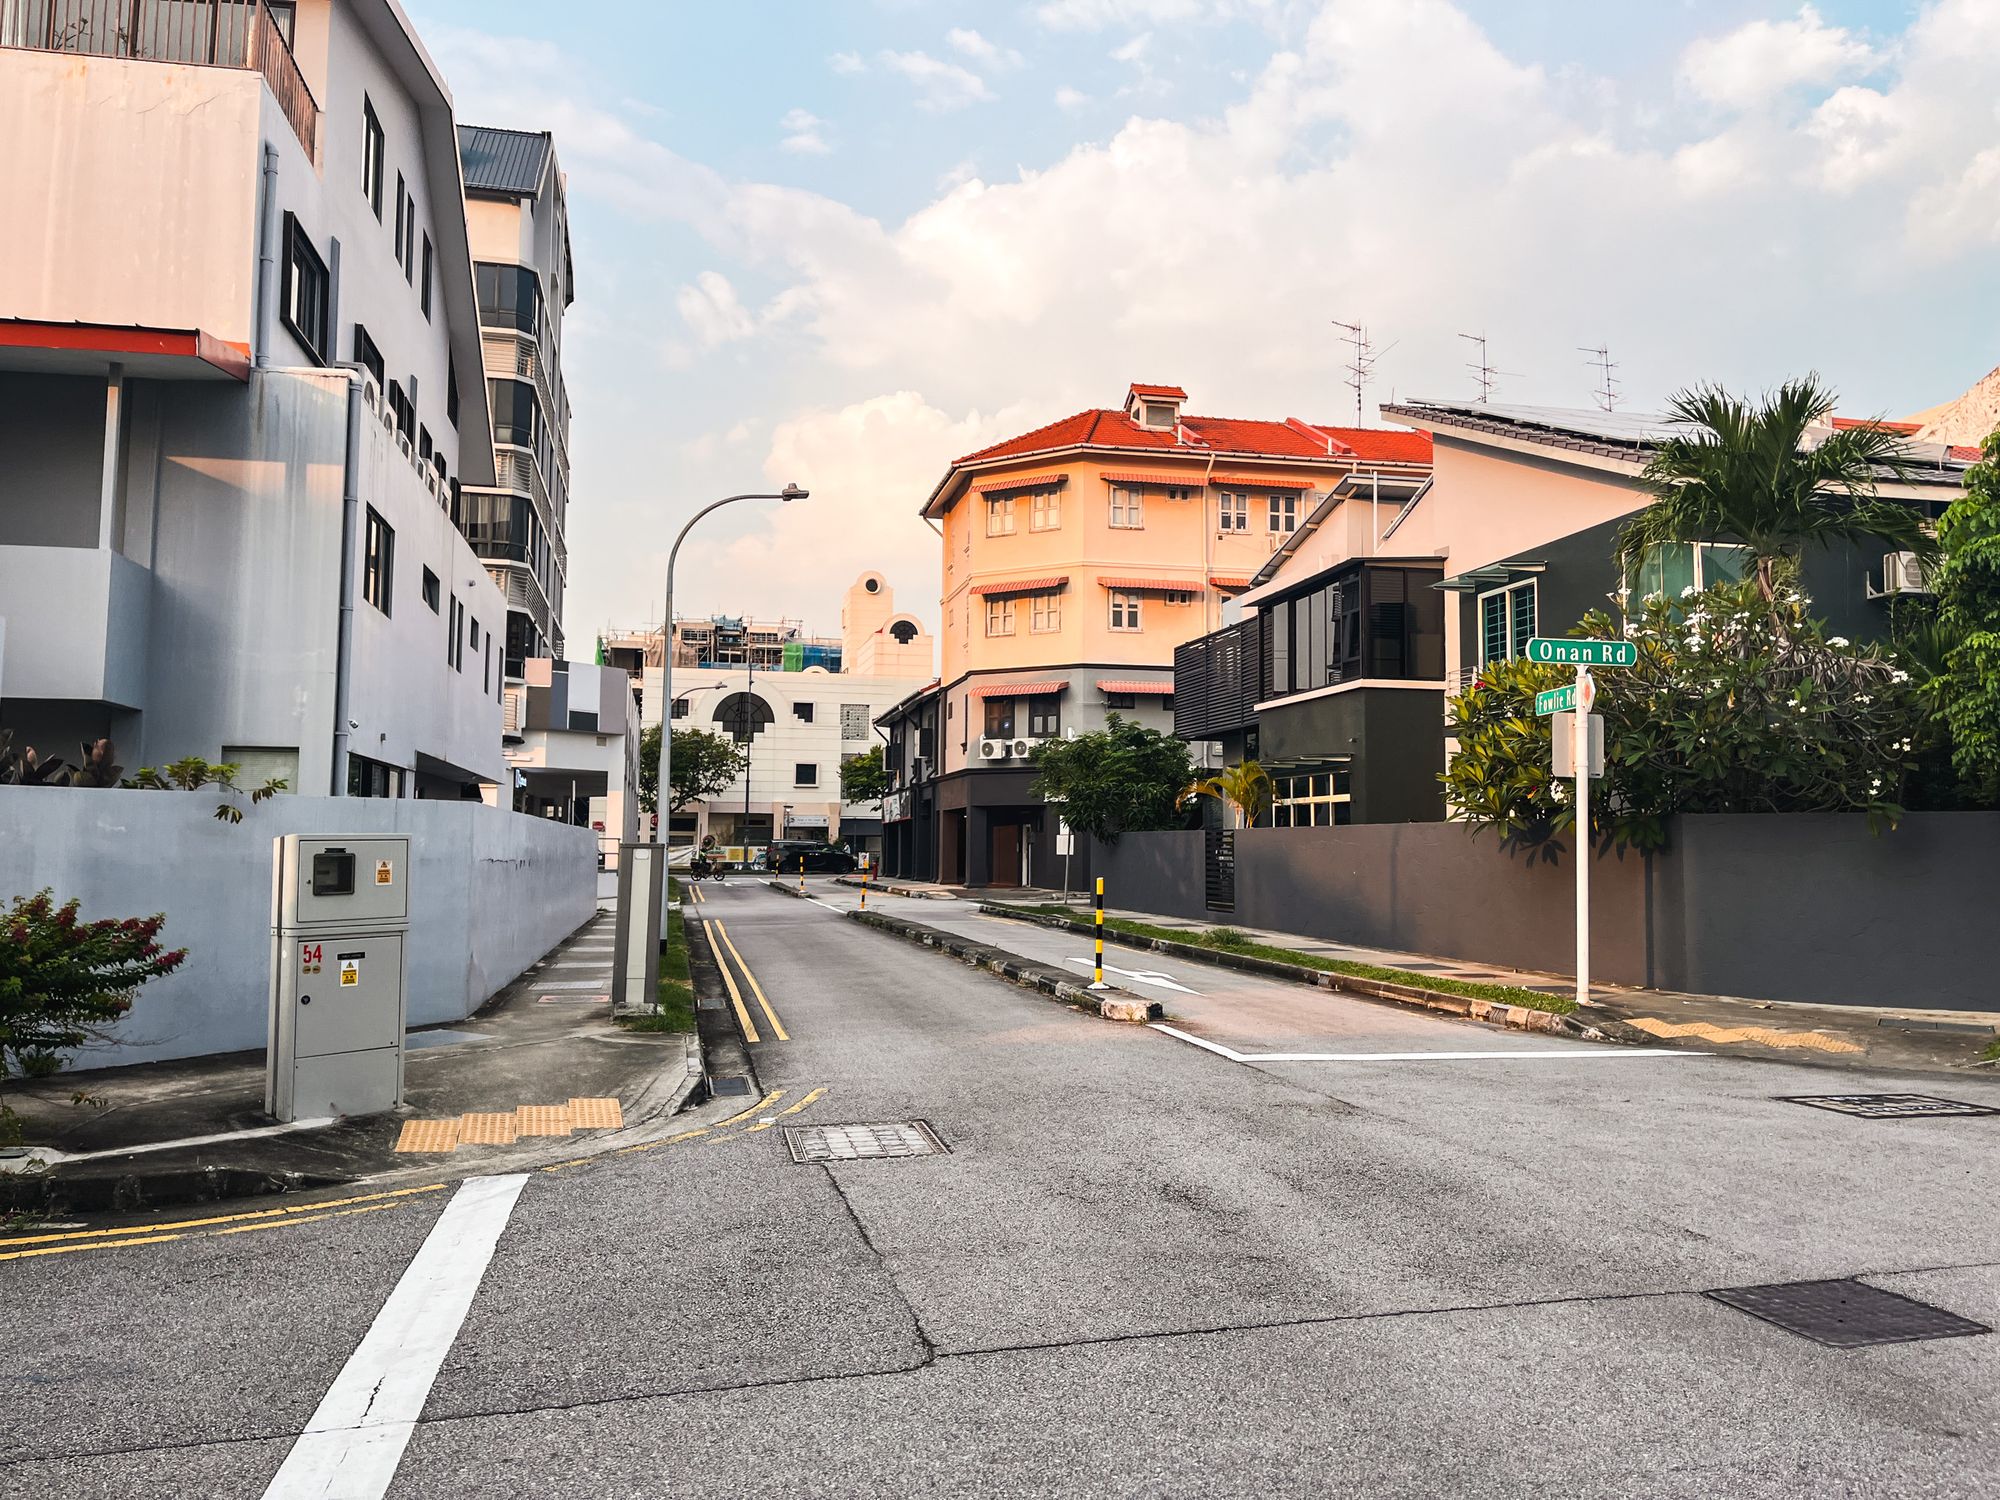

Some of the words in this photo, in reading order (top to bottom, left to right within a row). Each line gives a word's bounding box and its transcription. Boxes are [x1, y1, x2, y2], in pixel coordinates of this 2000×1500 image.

[1540, 642, 1592, 661] Onan
[1602, 645, 1626, 663] Rd
[1538, 692, 1563, 712] Fowlie
[303, 944, 322, 963] 54
